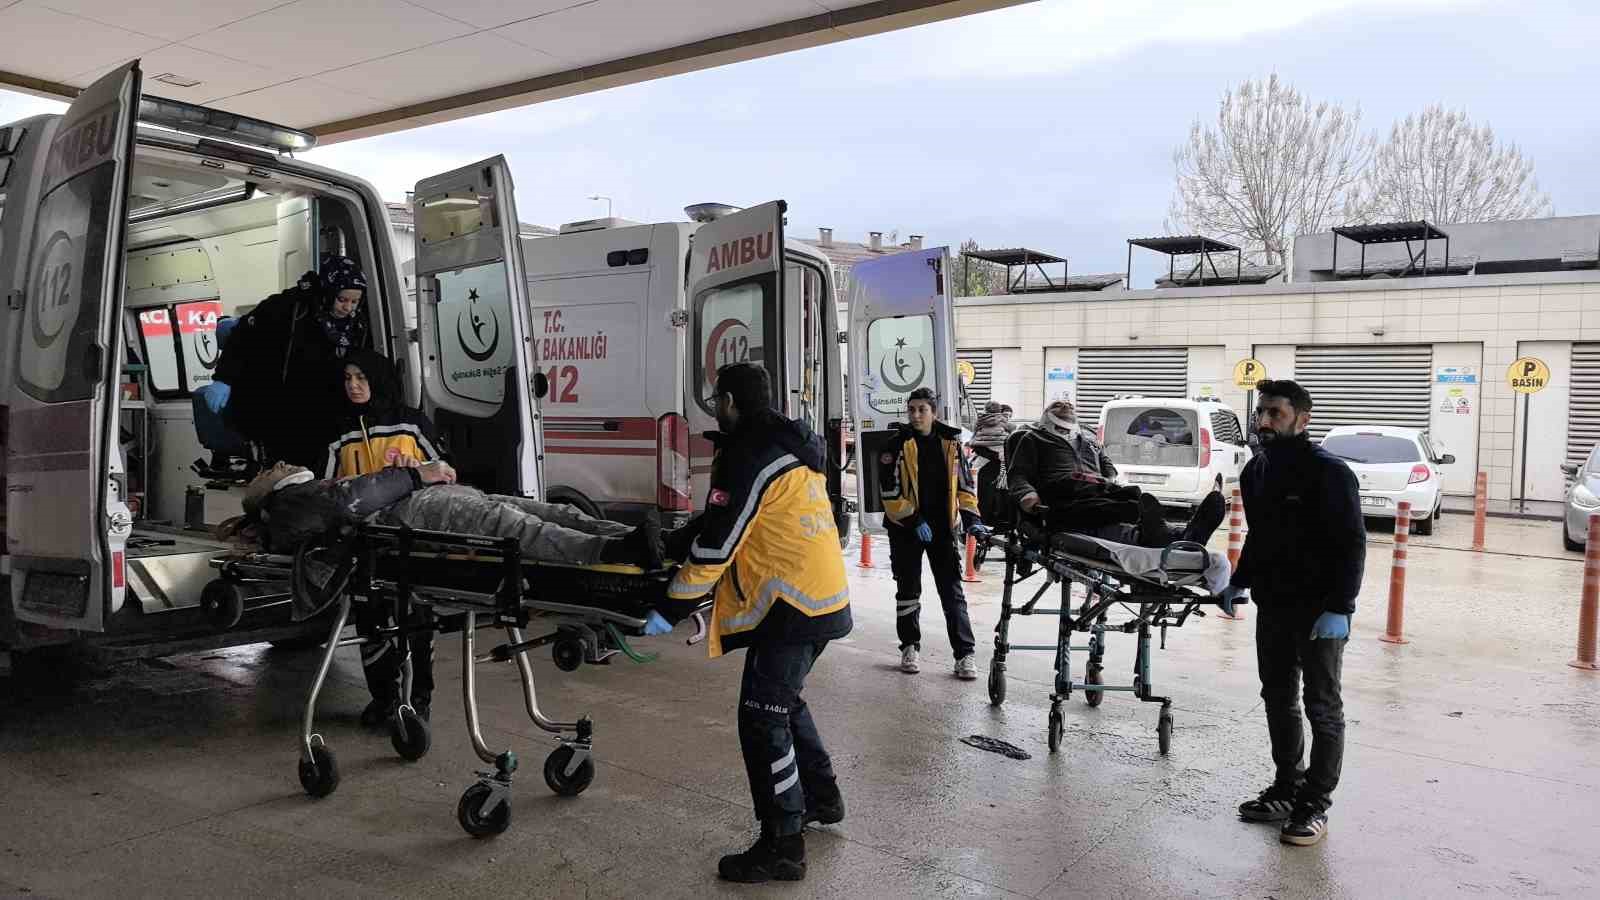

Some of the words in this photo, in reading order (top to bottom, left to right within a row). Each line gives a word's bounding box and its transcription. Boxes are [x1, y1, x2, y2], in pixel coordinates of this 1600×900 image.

[706, 231, 773, 273] AMBU
[39, 262, 73, 312] 112
[543, 310, 565, 333] T.C.
[543, 331, 607, 360] BAKANLIĞI
[720, 336, 748, 364] 112
[1245, 362, 1255, 375] P
[1524, 361, 1536, 376] P
[540, 365, 578, 403] 12
